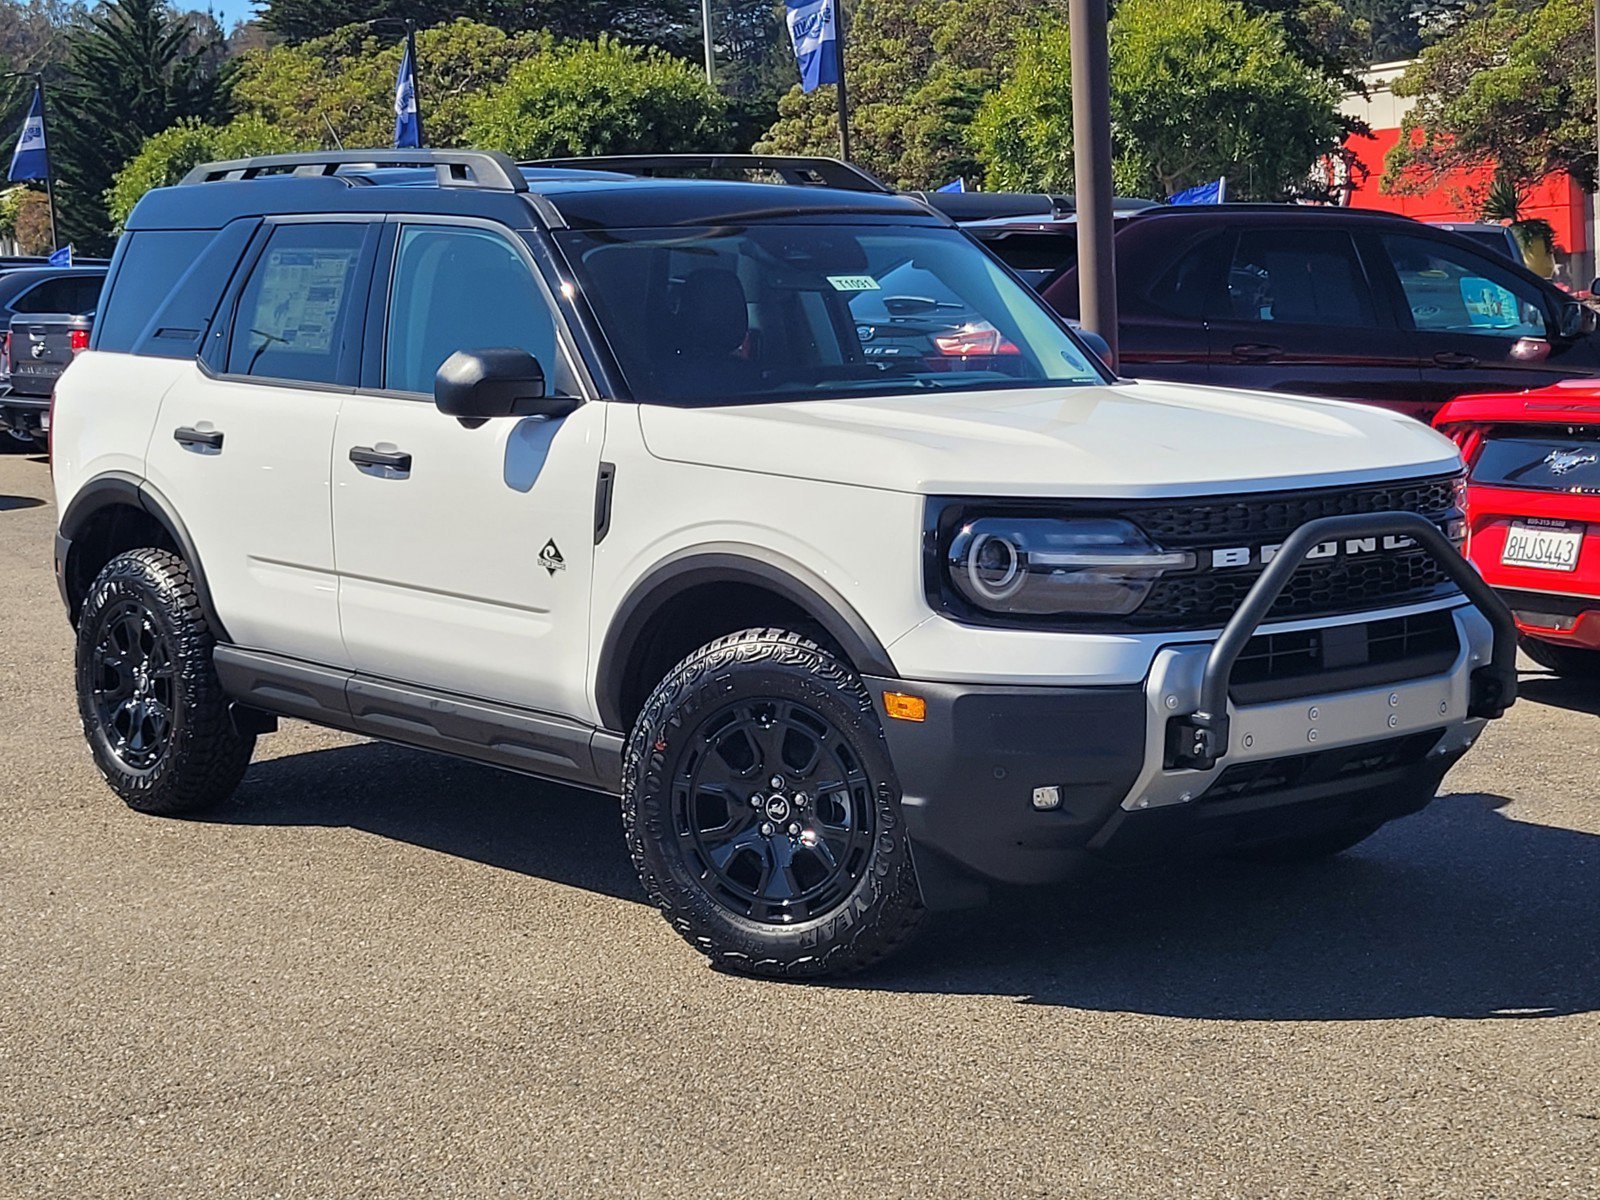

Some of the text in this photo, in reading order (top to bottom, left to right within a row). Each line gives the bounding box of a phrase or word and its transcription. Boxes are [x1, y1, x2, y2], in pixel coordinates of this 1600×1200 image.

[836, 279, 873, 289] T1091
[1212, 526, 1441, 568] BONC
[1507, 536, 1574, 562] 8HJS443
